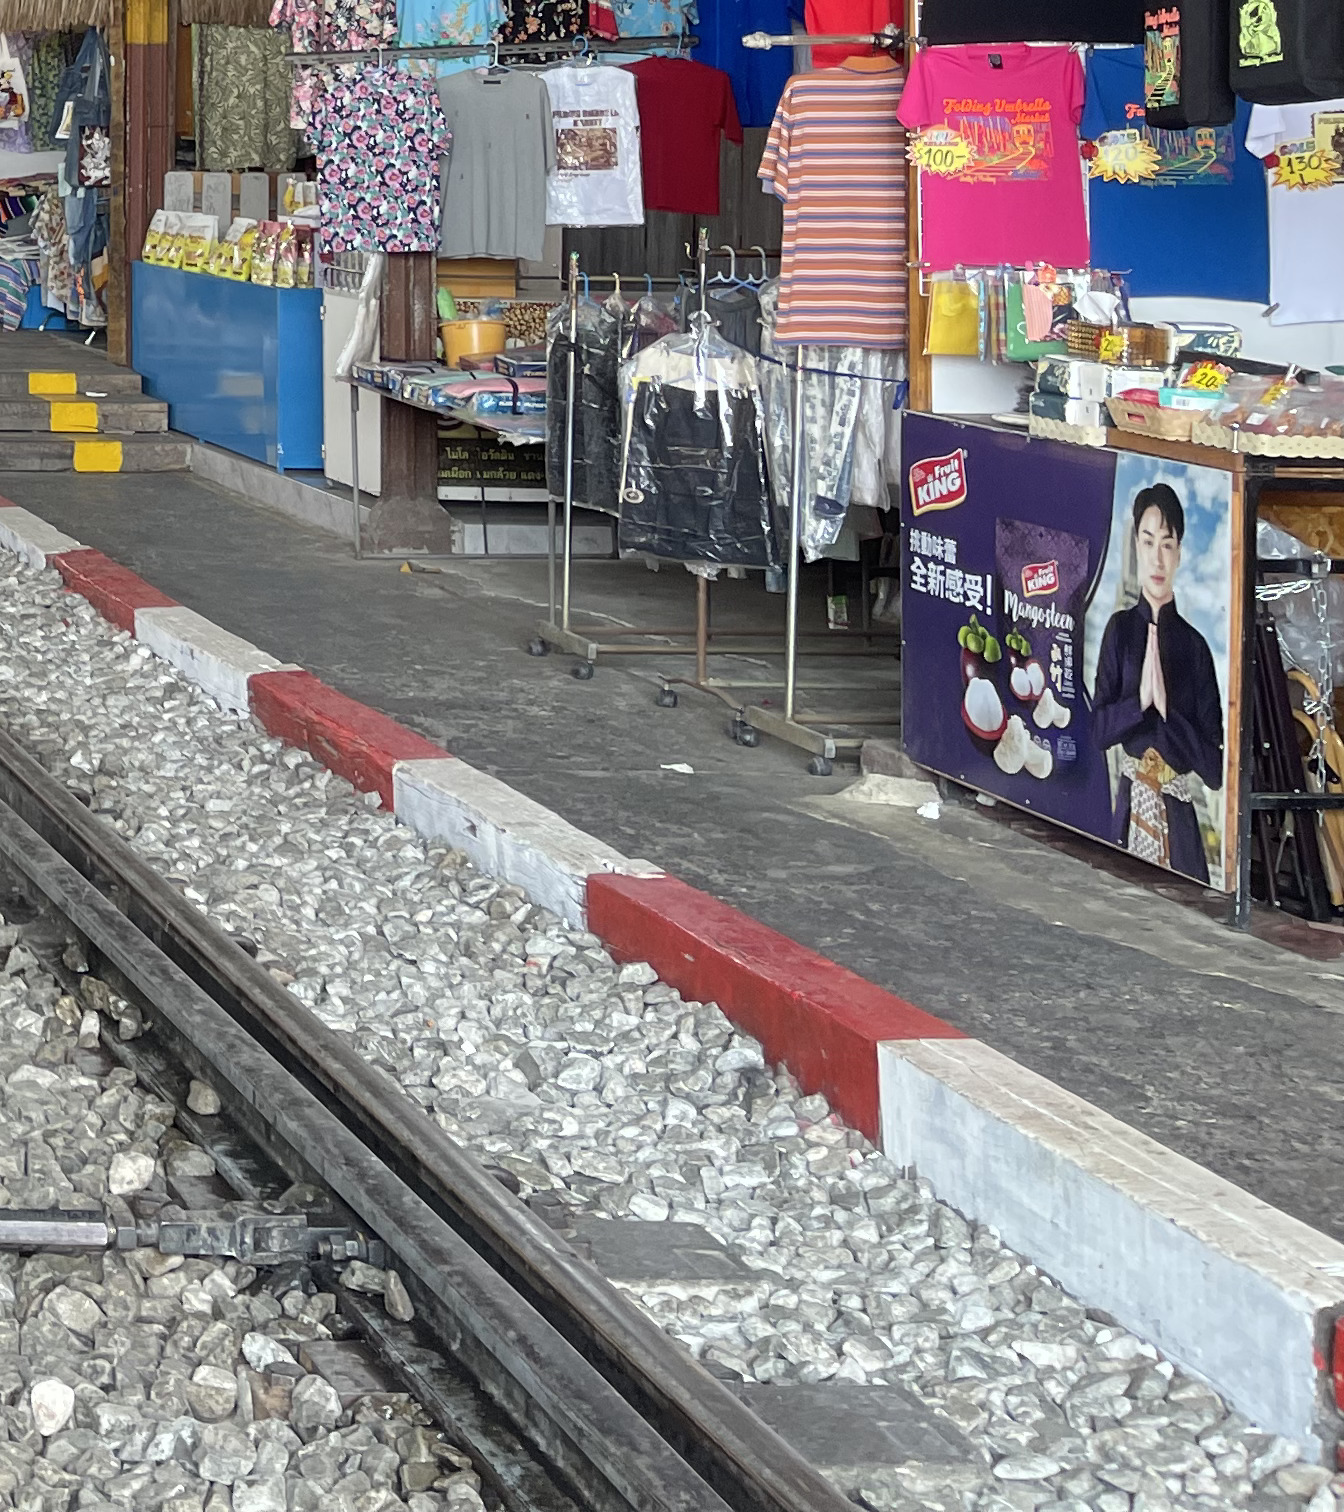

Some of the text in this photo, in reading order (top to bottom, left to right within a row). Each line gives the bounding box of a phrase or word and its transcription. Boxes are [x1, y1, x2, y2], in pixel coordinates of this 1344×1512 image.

[943, 97, 1051, 115] Folding Umbrella
[1012, 112, 1050, 124] Market
[1286, 155, 1322, 173] 130
[934, 458, 959, 477] Fruit
[917, 472, 962, 506] KING
[1039, 565, 1054, 577] Fruit
[1027, 572, 1056, 592] KING
[1003, 589, 1076, 632] Mangosteen
